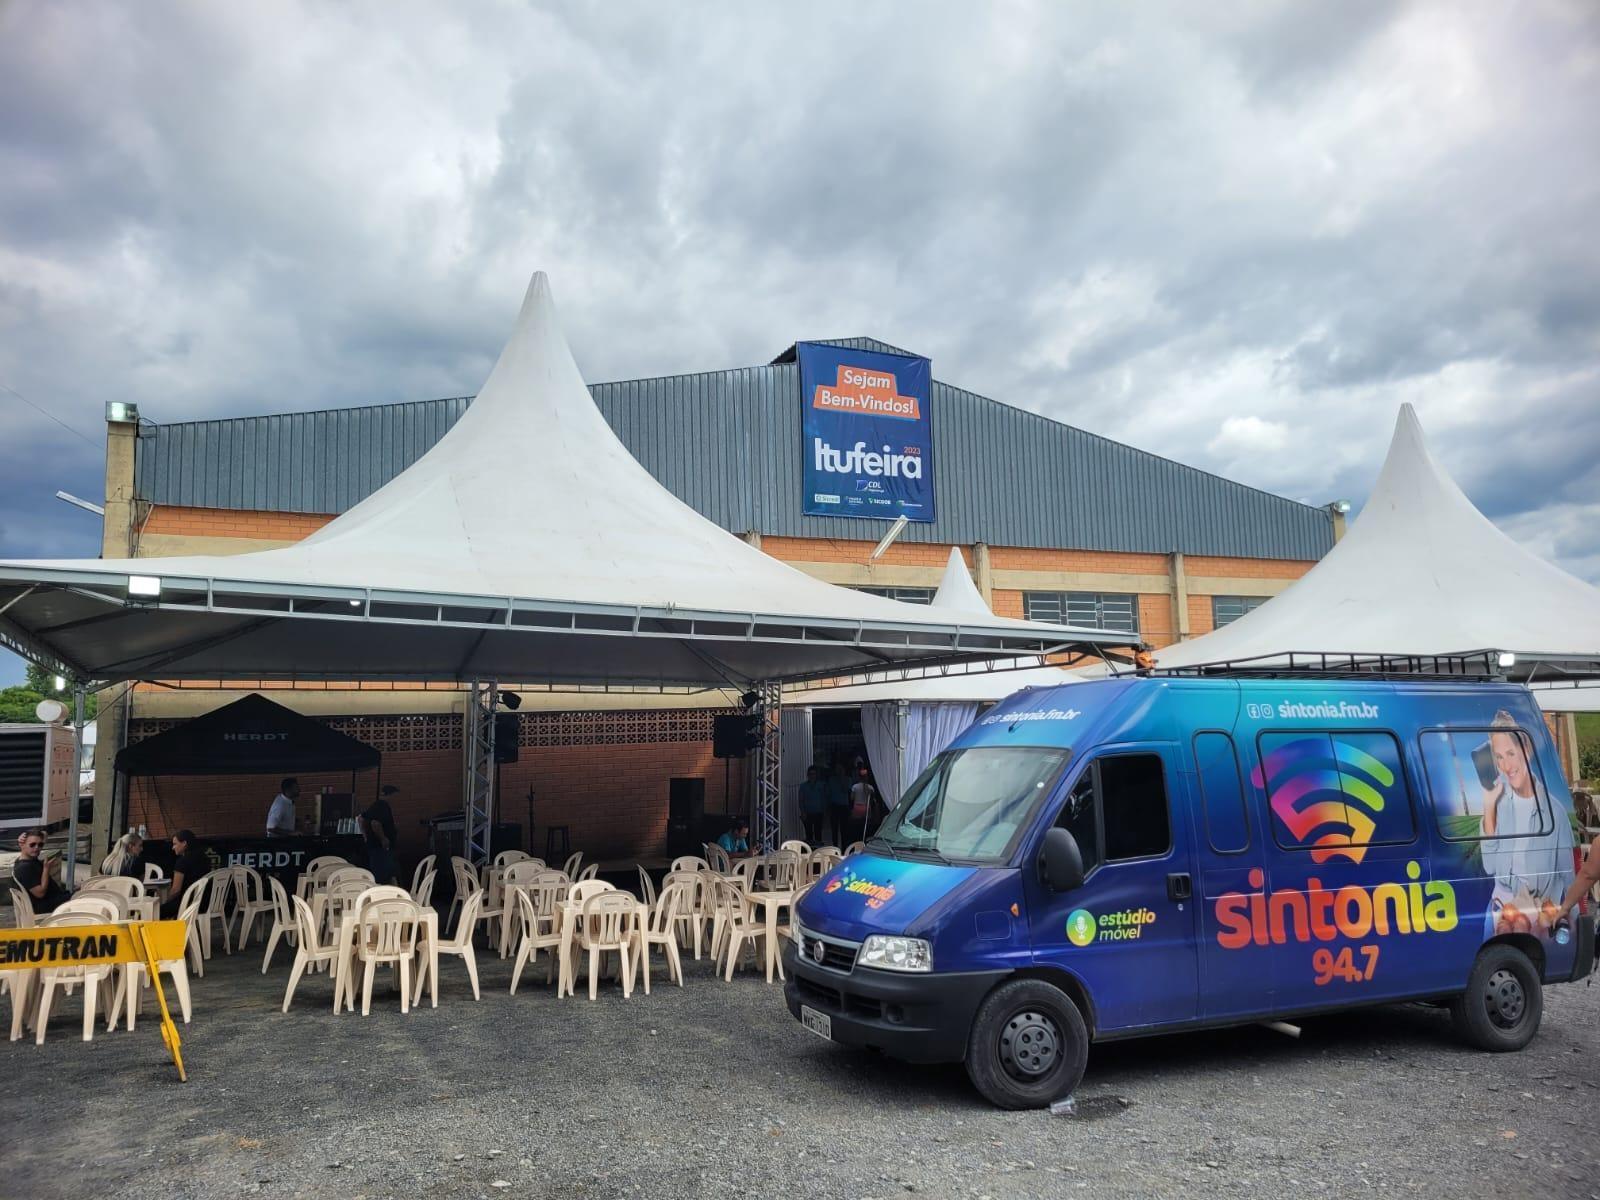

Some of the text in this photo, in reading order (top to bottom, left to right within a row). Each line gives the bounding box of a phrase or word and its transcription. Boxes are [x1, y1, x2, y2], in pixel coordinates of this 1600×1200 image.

[843, 369, 891, 389] Sejam
[821, 390, 914, 414] Bem-Vindos!
[814, 437, 922, 479] Itufeira
[904, 446, 921, 455] 2023
[1278, 700, 1379, 719] sintonia.fm.br
[224, 732, 289, 741] HERDT
[228, 851, 305, 869] HERDT
[1215, 860, 1459, 949] sintonia
[1099, 907, 1157, 927] estúdio
[1099, 924, 1142, 941] móvel
[1312, 945, 1380, 986] 94.7
